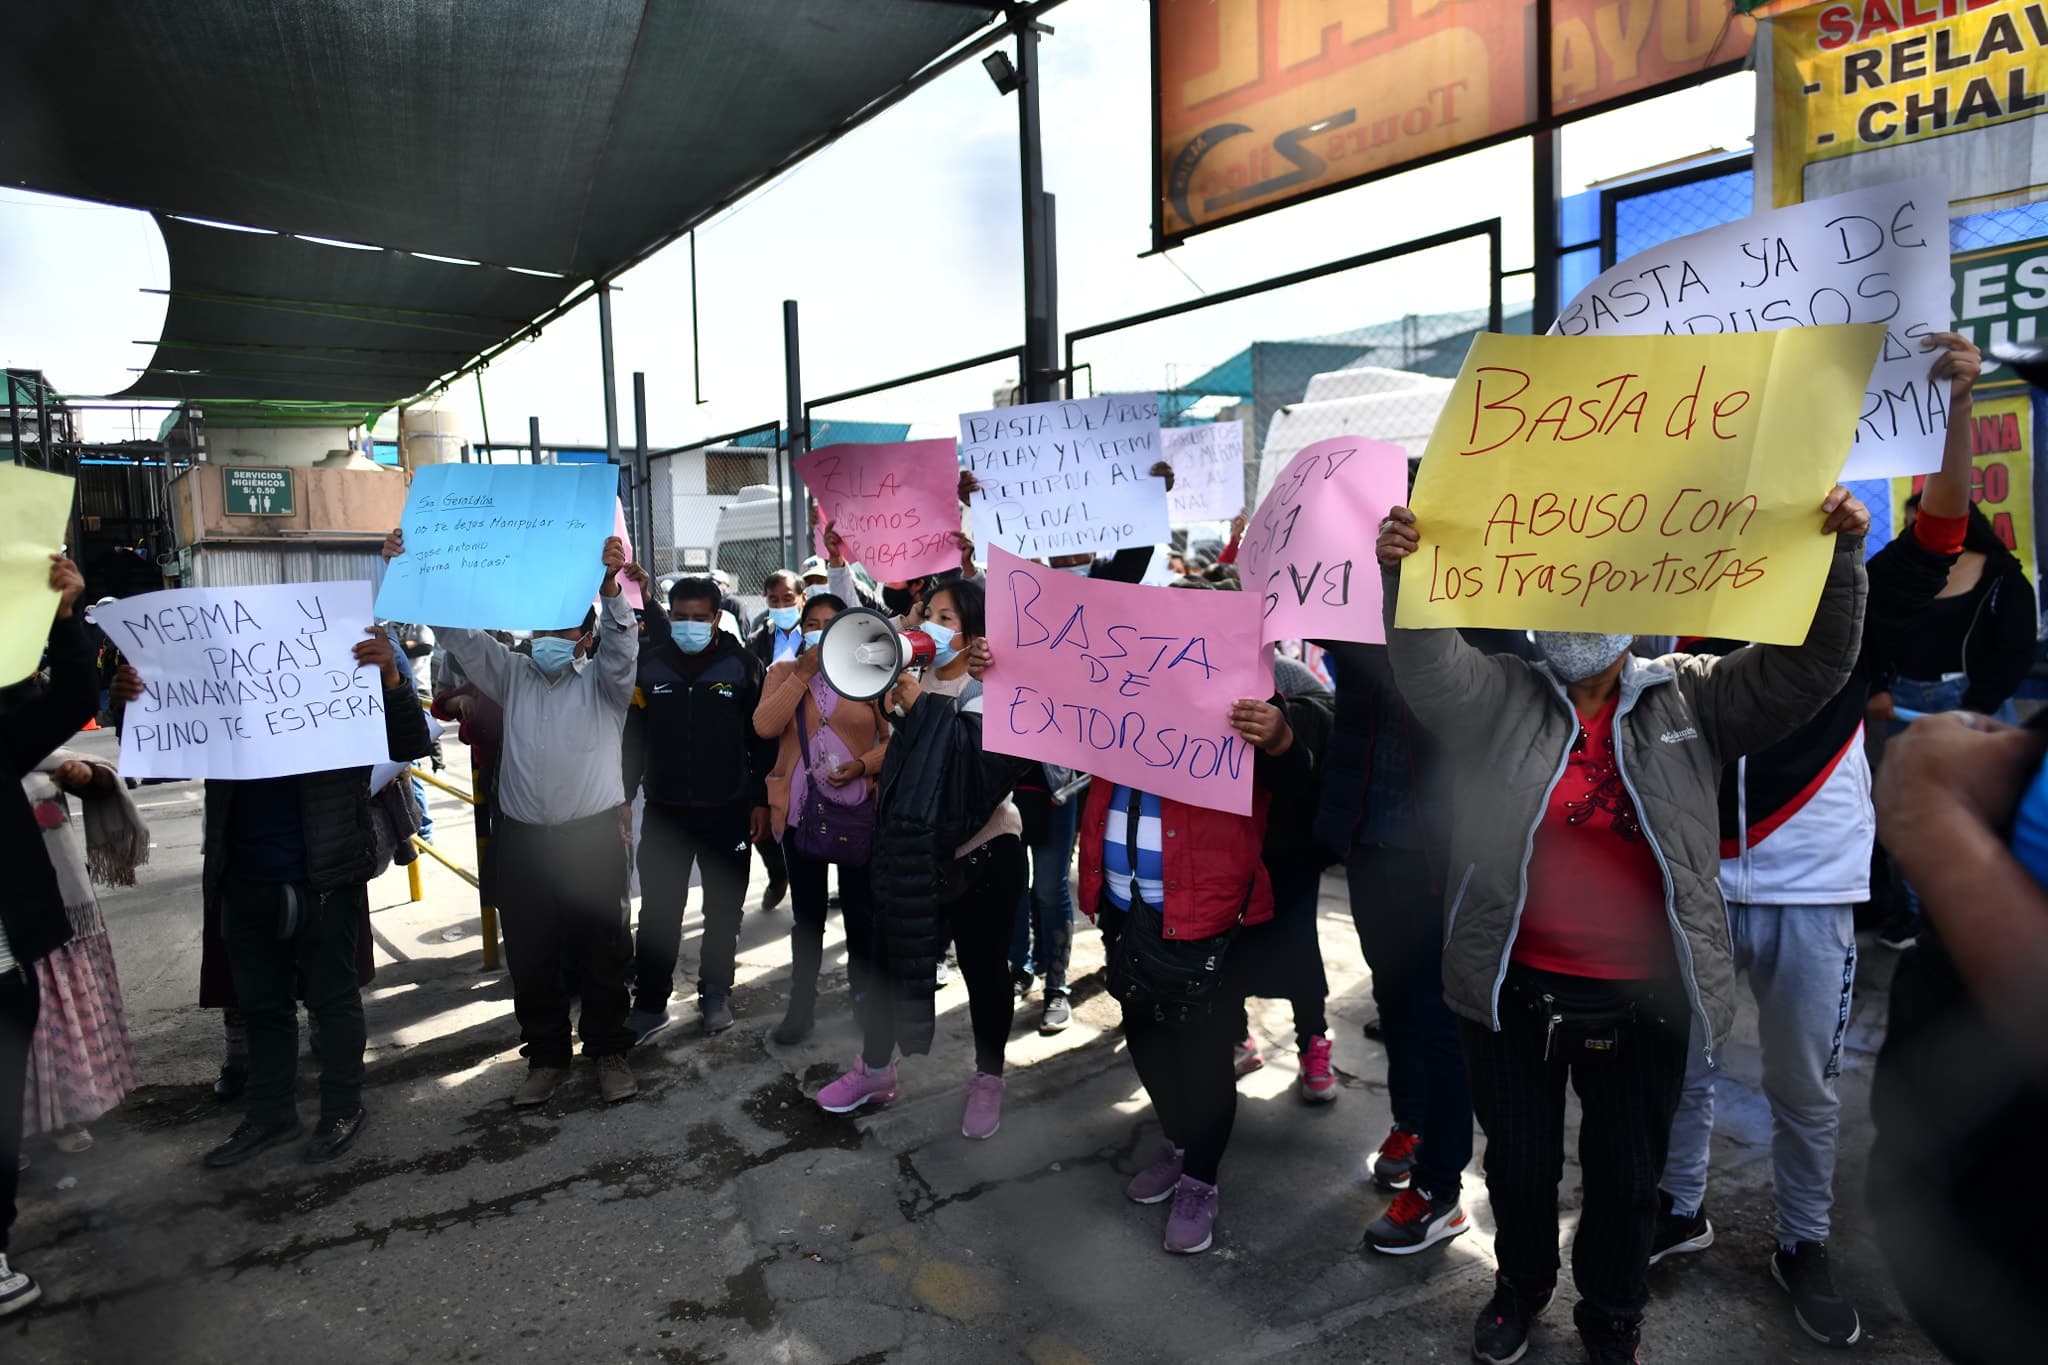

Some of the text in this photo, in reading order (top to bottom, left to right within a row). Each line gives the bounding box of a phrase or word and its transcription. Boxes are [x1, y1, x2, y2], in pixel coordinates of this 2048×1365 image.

[1558, 200, 1926, 336] BASTA YA DE
[1665, 365, 1750, 441] de
[968, 412, 1053, 445] BASTA
[233, 471, 283, 480] SERVICIOS
[256, 487, 276, 495] 0.50
[813, 455, 903, 499] ZILA
[1110, 462, 1147, 486] AL
[988, 501, 1103, 535] PENAL
[1484, 492, 1648, 547] ABUSO
[122, 596, 328, 649] MERMA Y
[1008, 569, 1222, 680] BASTA
[203, 634, 322, 680] PACAY
[143, 665, 370, 713] YANAMAYO DE
[132, 693, 385, 753] PUNO TE ESPERA
[1009, 686, 1250, 781] EXTORSION
